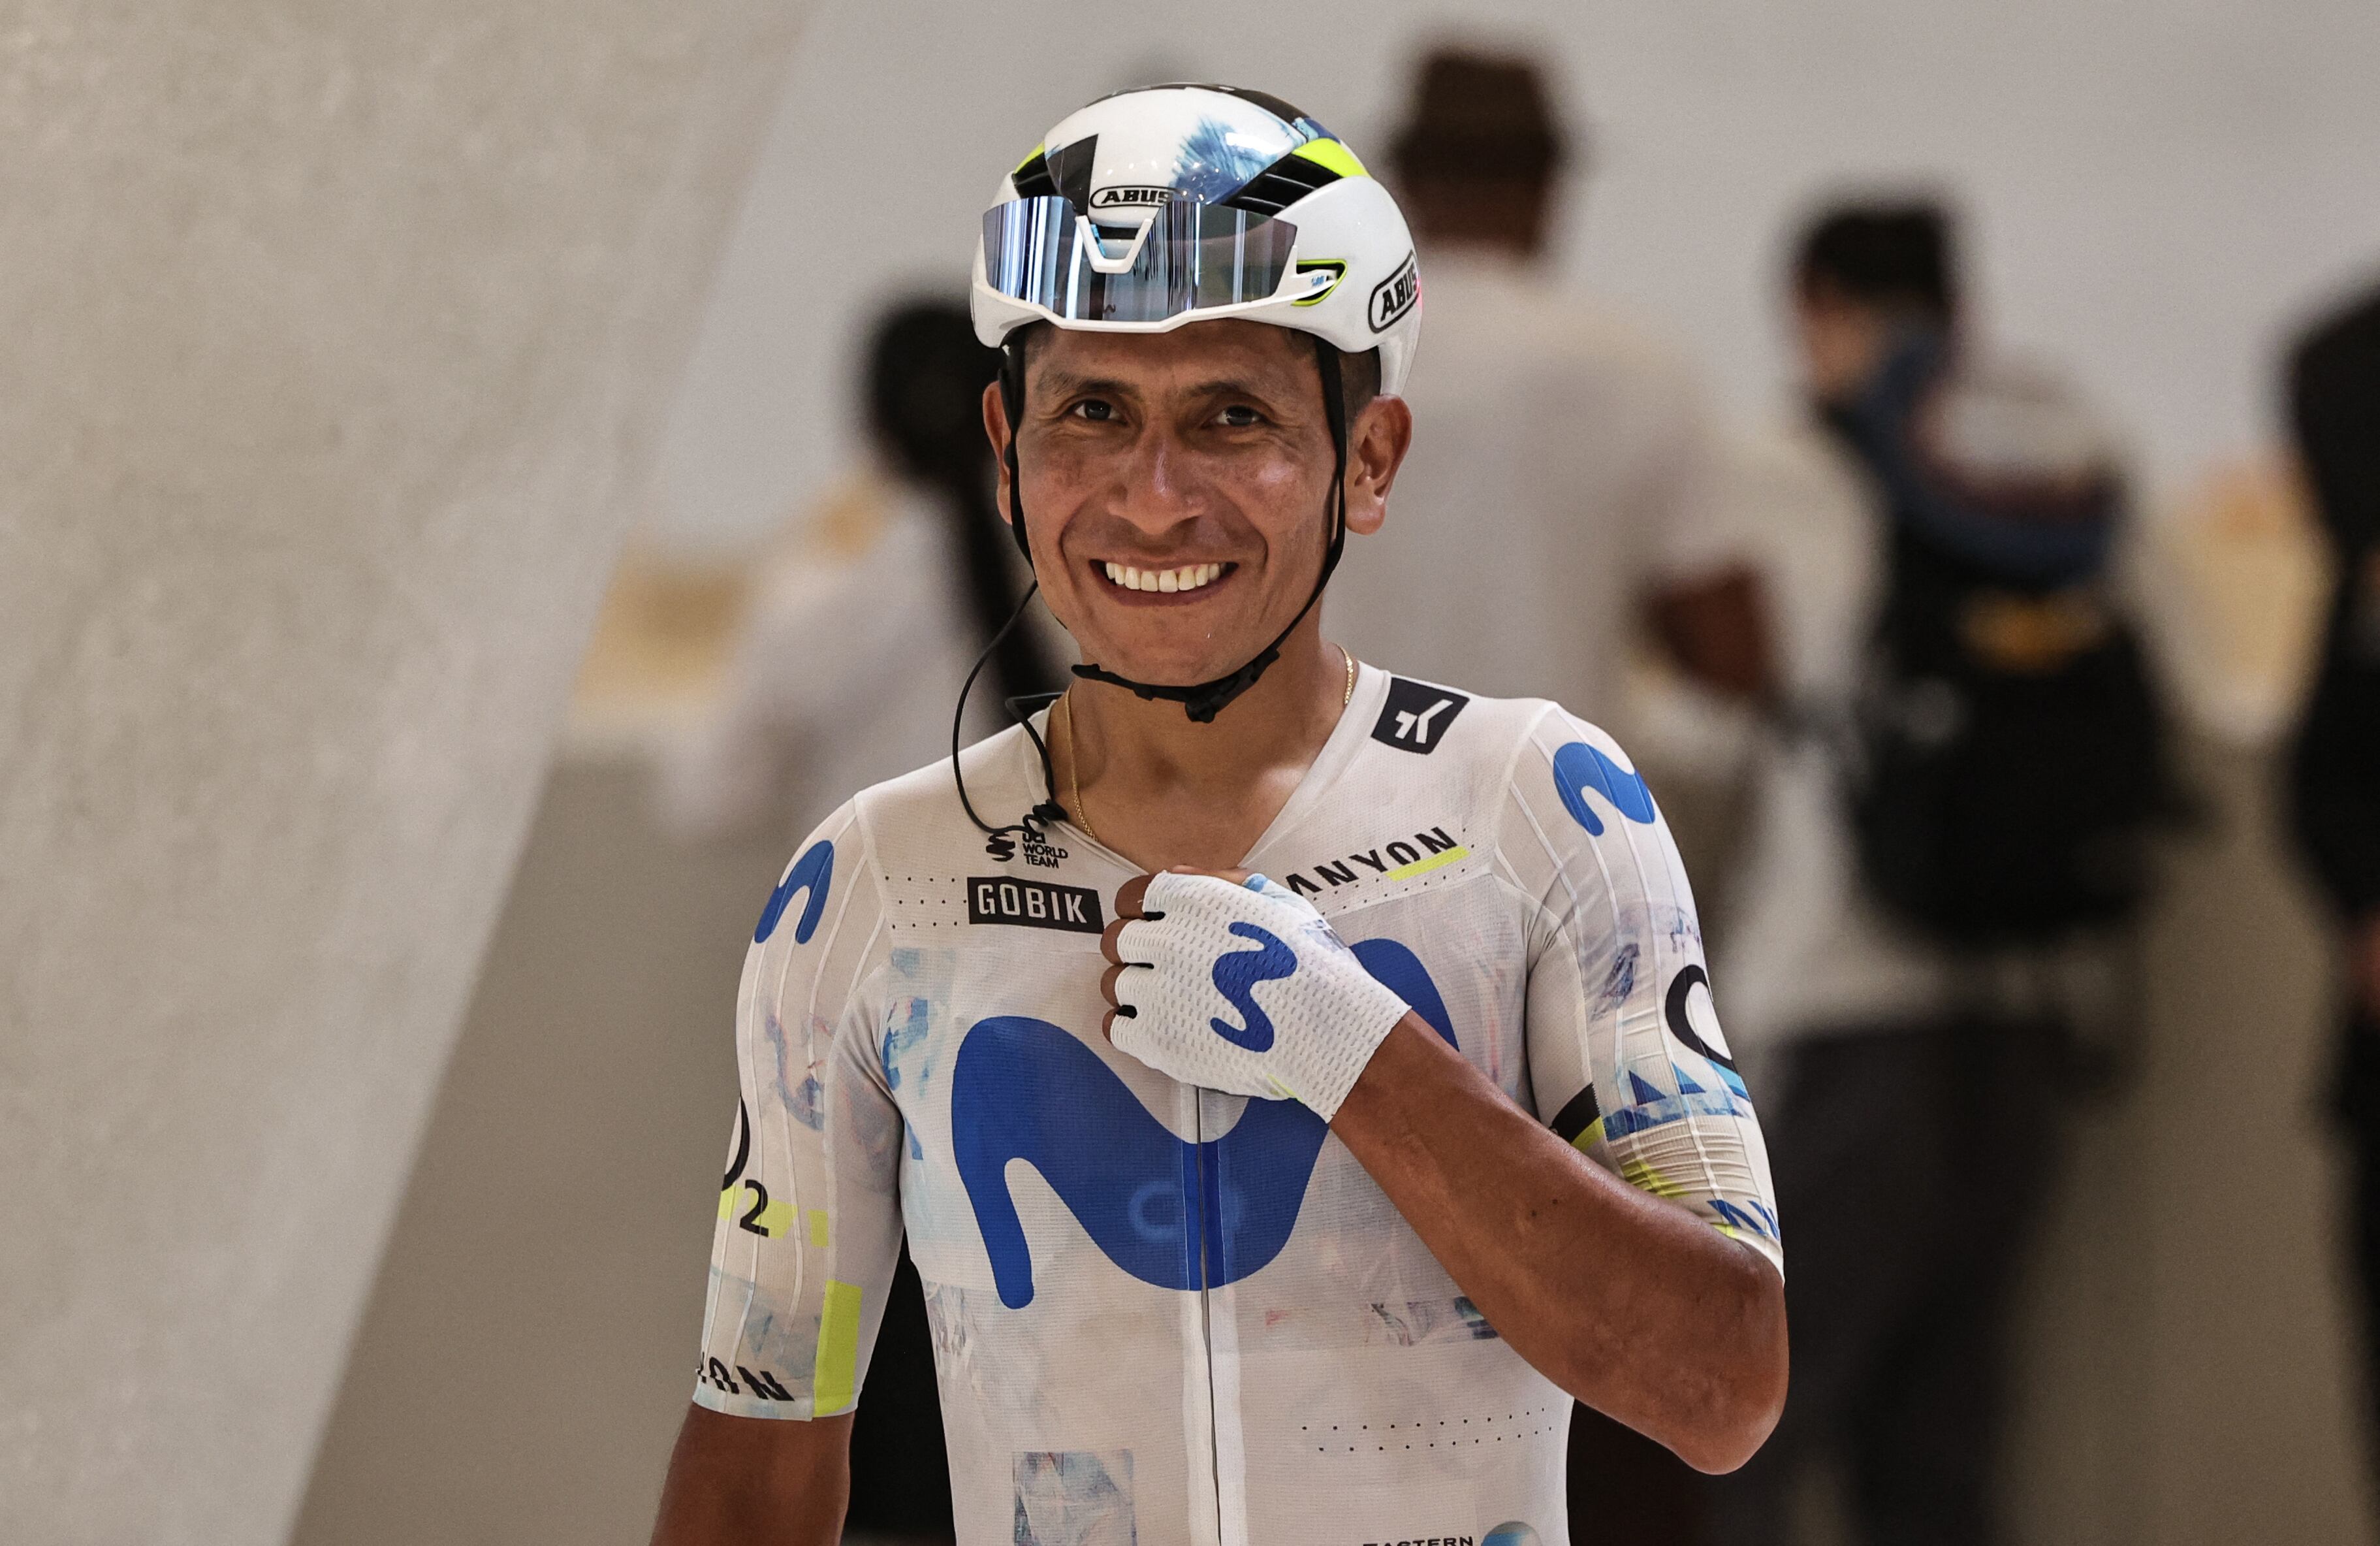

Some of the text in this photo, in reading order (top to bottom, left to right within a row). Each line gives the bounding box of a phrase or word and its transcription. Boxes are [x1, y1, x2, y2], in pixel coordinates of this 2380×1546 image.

[1102, 189, 1172, 204] ABUS
[1023, 843, 1068, 859] WORLD
[1024, 854, 1059, 869] TEAM
[1285, 826, 1457, 896] ANYON
[977, 884, 1087, 923] GOBIK
